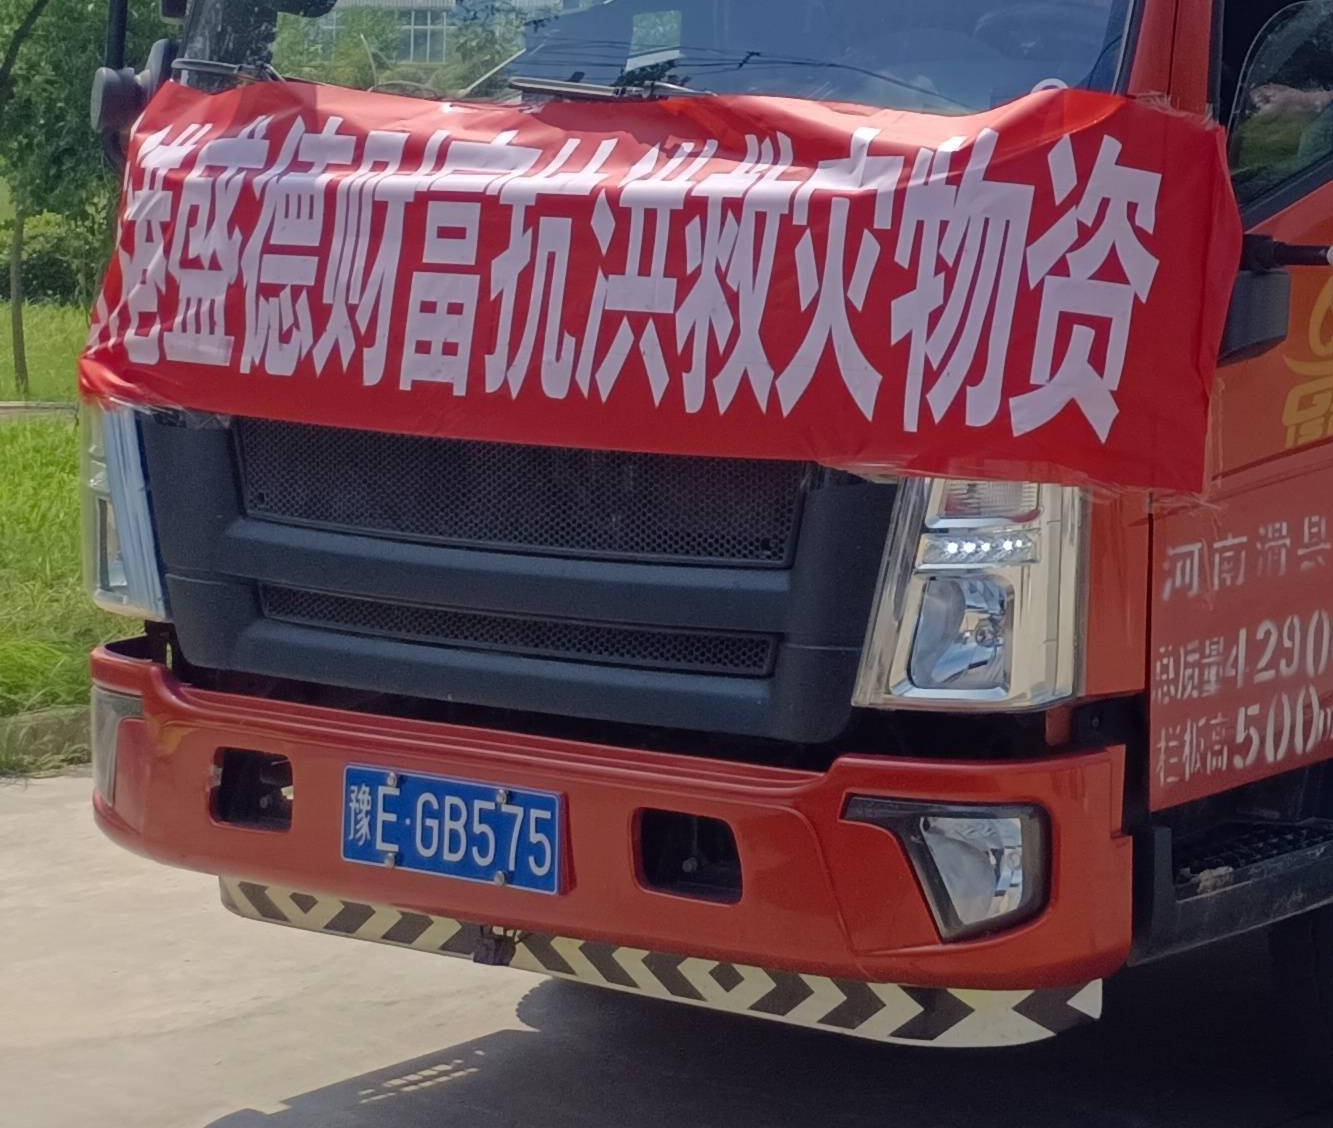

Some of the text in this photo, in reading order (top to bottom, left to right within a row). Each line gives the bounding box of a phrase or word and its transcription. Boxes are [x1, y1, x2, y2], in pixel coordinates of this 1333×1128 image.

[82, 115, 1163, 443] 港盛德财富抗洪救灾物资
[1162, 515, 1332, 601] 河南滑县
